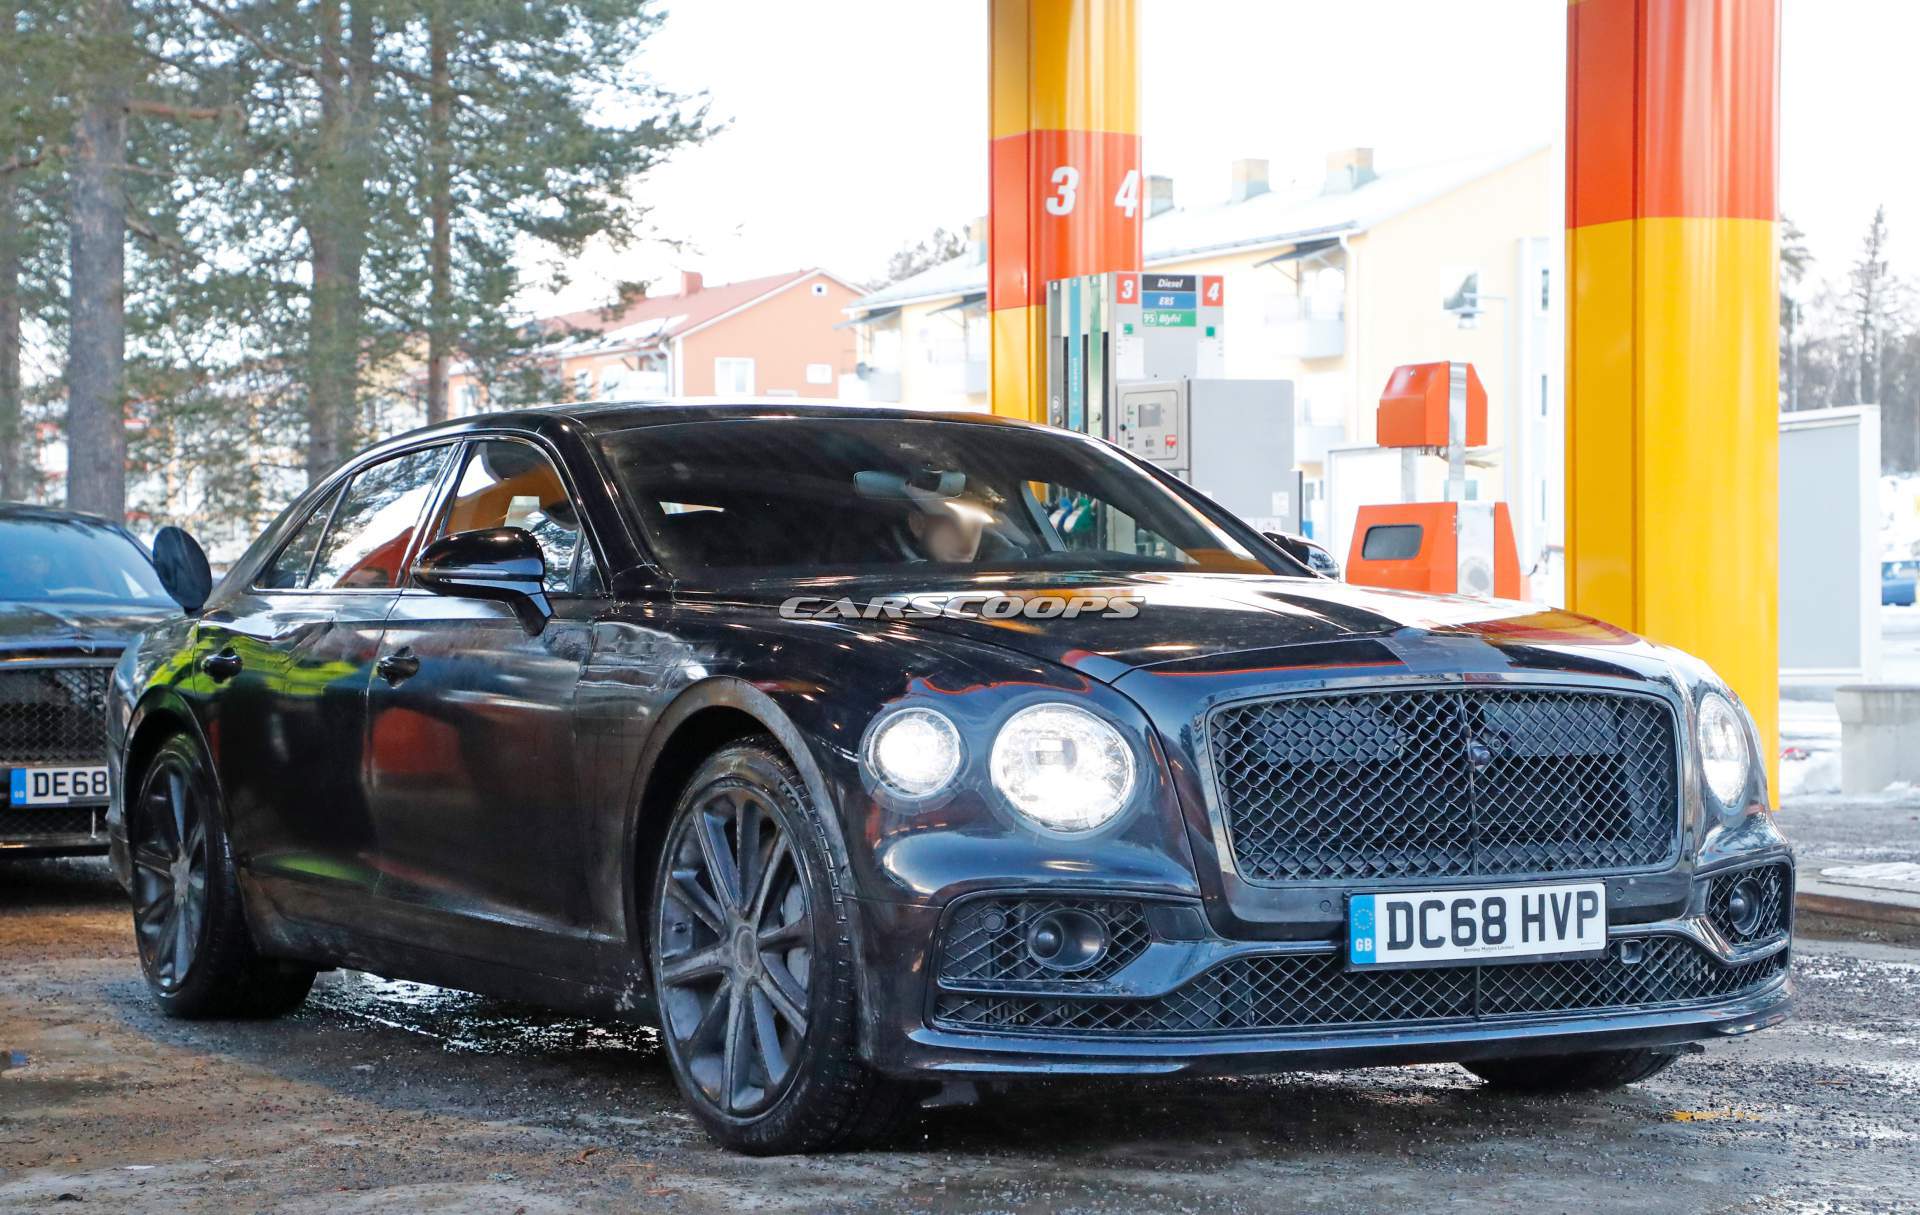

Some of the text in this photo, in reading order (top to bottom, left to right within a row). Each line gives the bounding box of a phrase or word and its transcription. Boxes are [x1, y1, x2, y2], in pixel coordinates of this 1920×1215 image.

[1045, 166, 1079, 216] 3
[1114, 170, 1139, 218] 4
[1122, 279, 1134, 299] 3
[1158, 278, 1183, 288] Diesel
[1207, 282, 1220, 301] 4
[1158, 297, 1175, 306] E85
[1144, 313, 1155, 323] 95
[33, 771, 107, 797] DE68
[1386, 890, 1599, 951] DC68 HVP
[1355, 938, 1373, 952] GB
